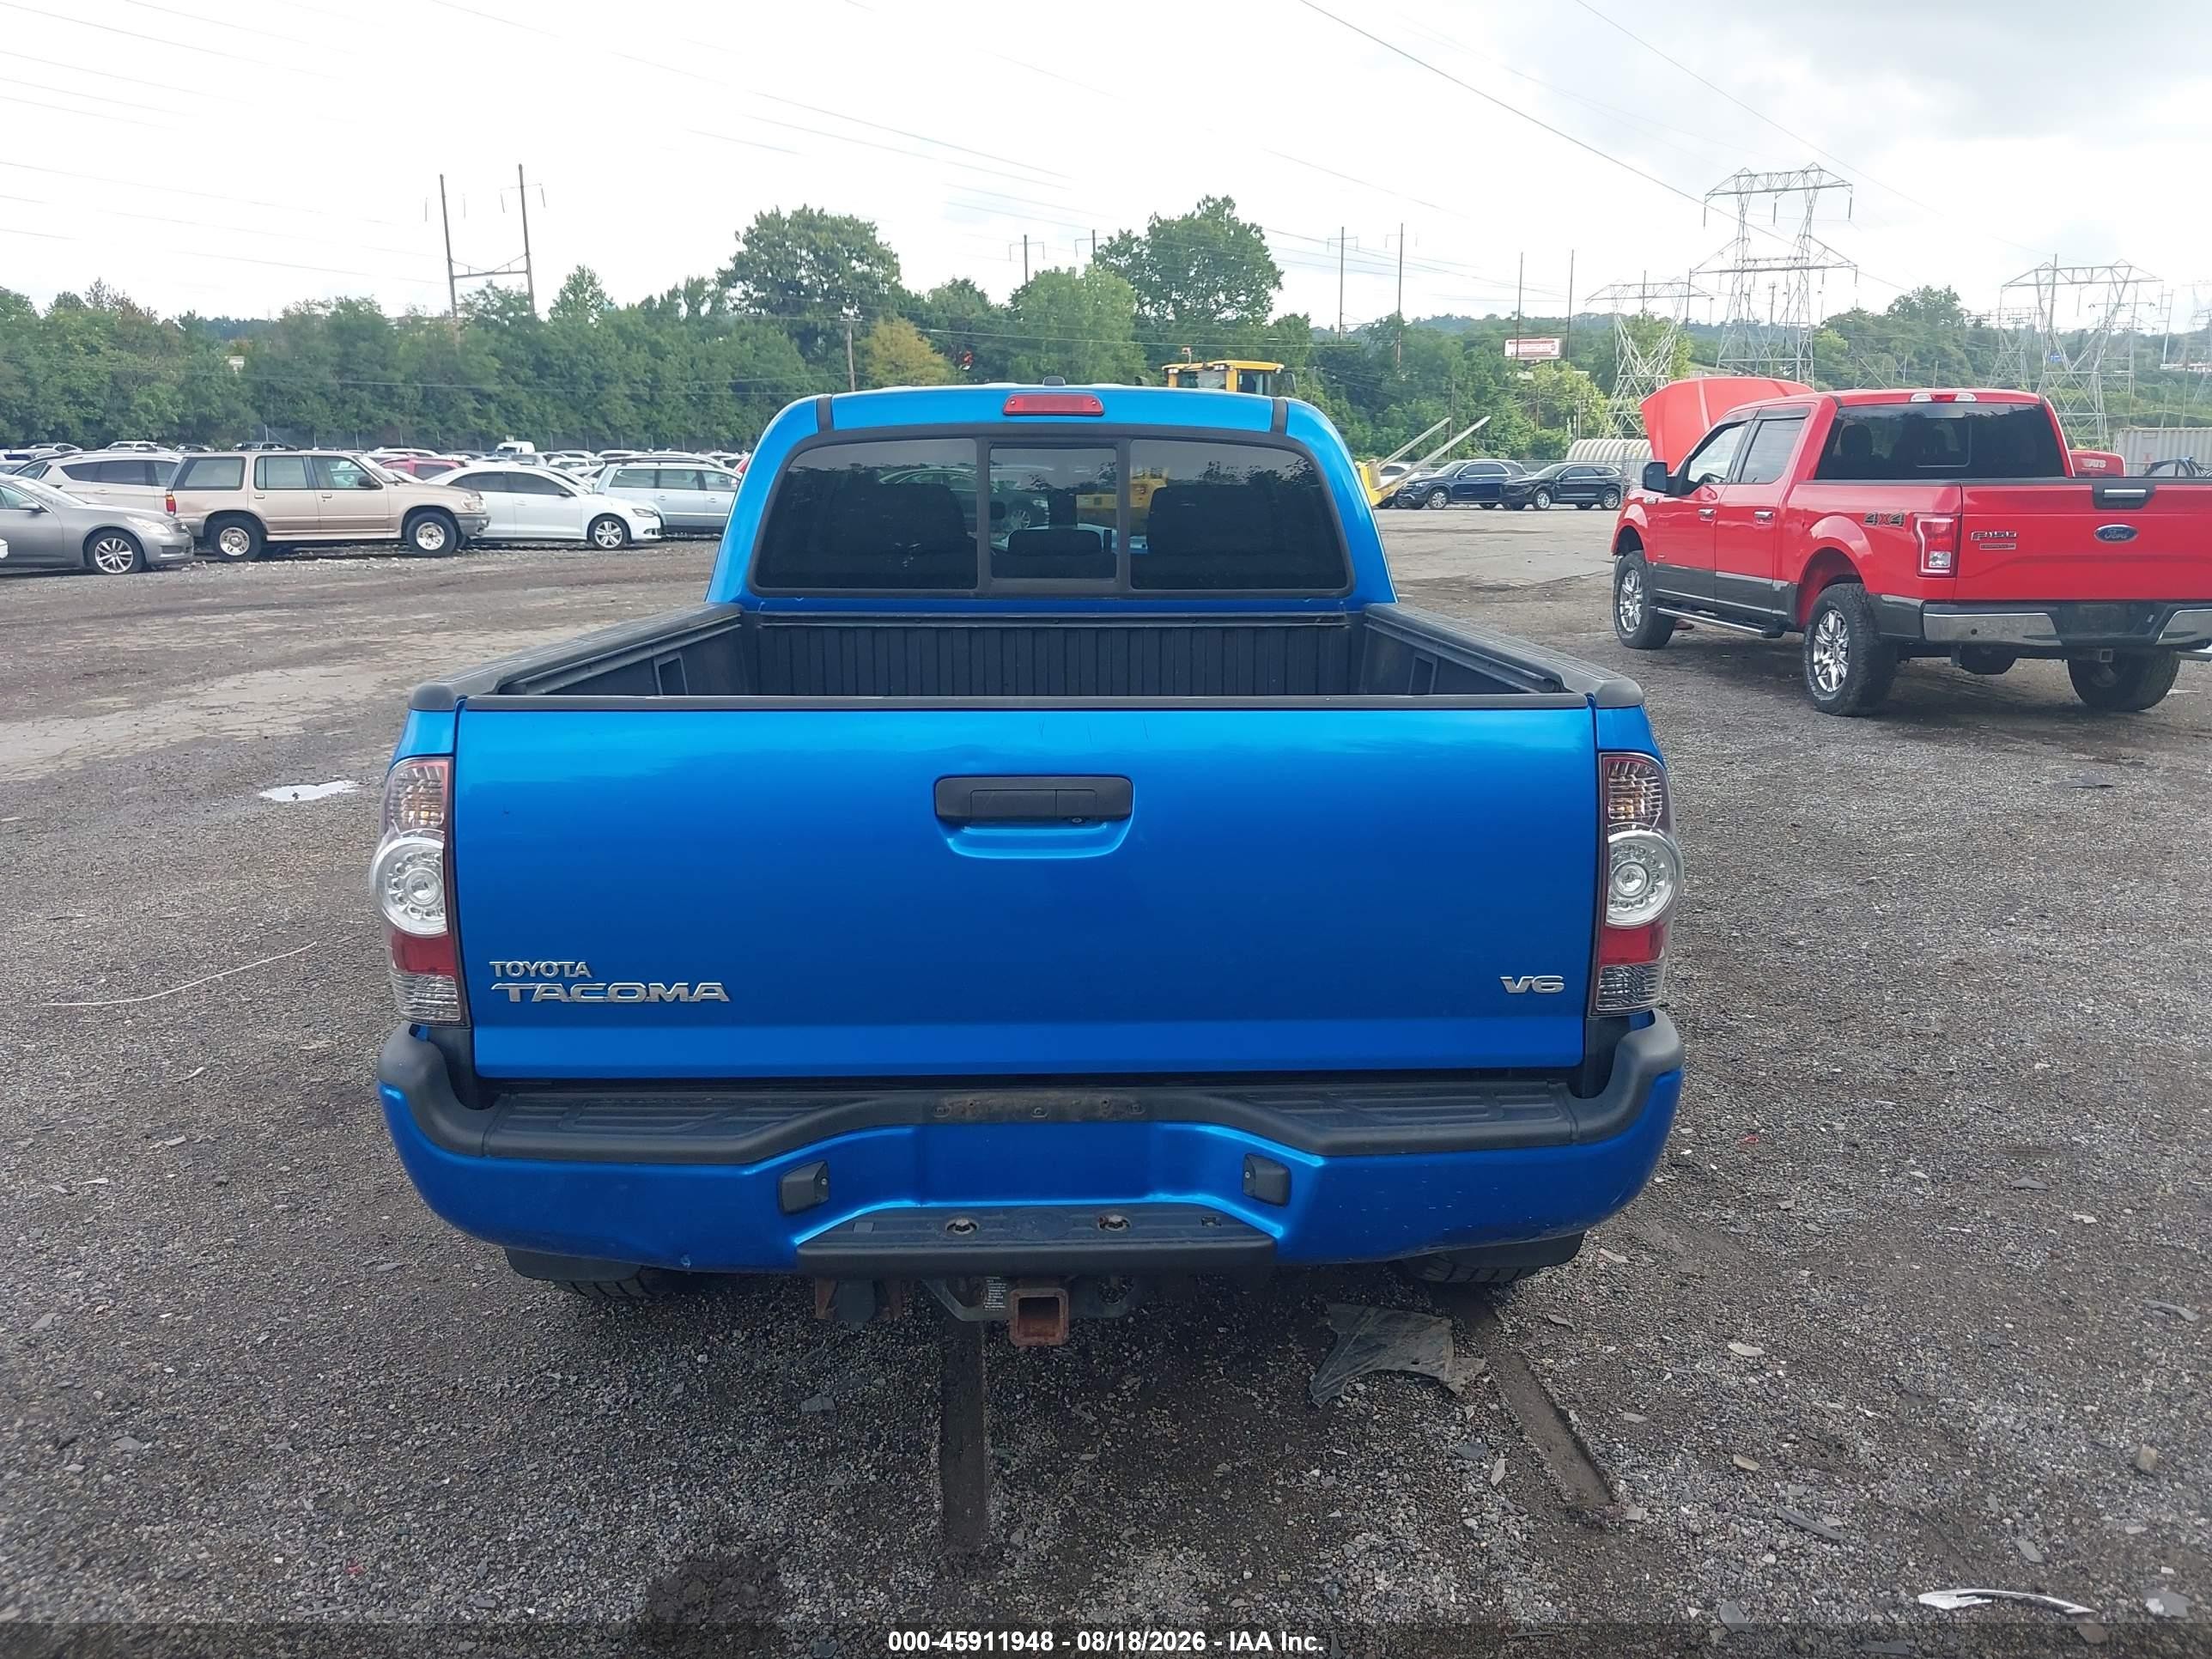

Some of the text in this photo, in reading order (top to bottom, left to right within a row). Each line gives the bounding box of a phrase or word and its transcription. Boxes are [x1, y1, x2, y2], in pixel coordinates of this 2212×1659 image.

[489, 961, 592, 978] TOYOTA
[491, 982, 730, 1003] TACOMA
[1499, 975, 1565, 994] V6
